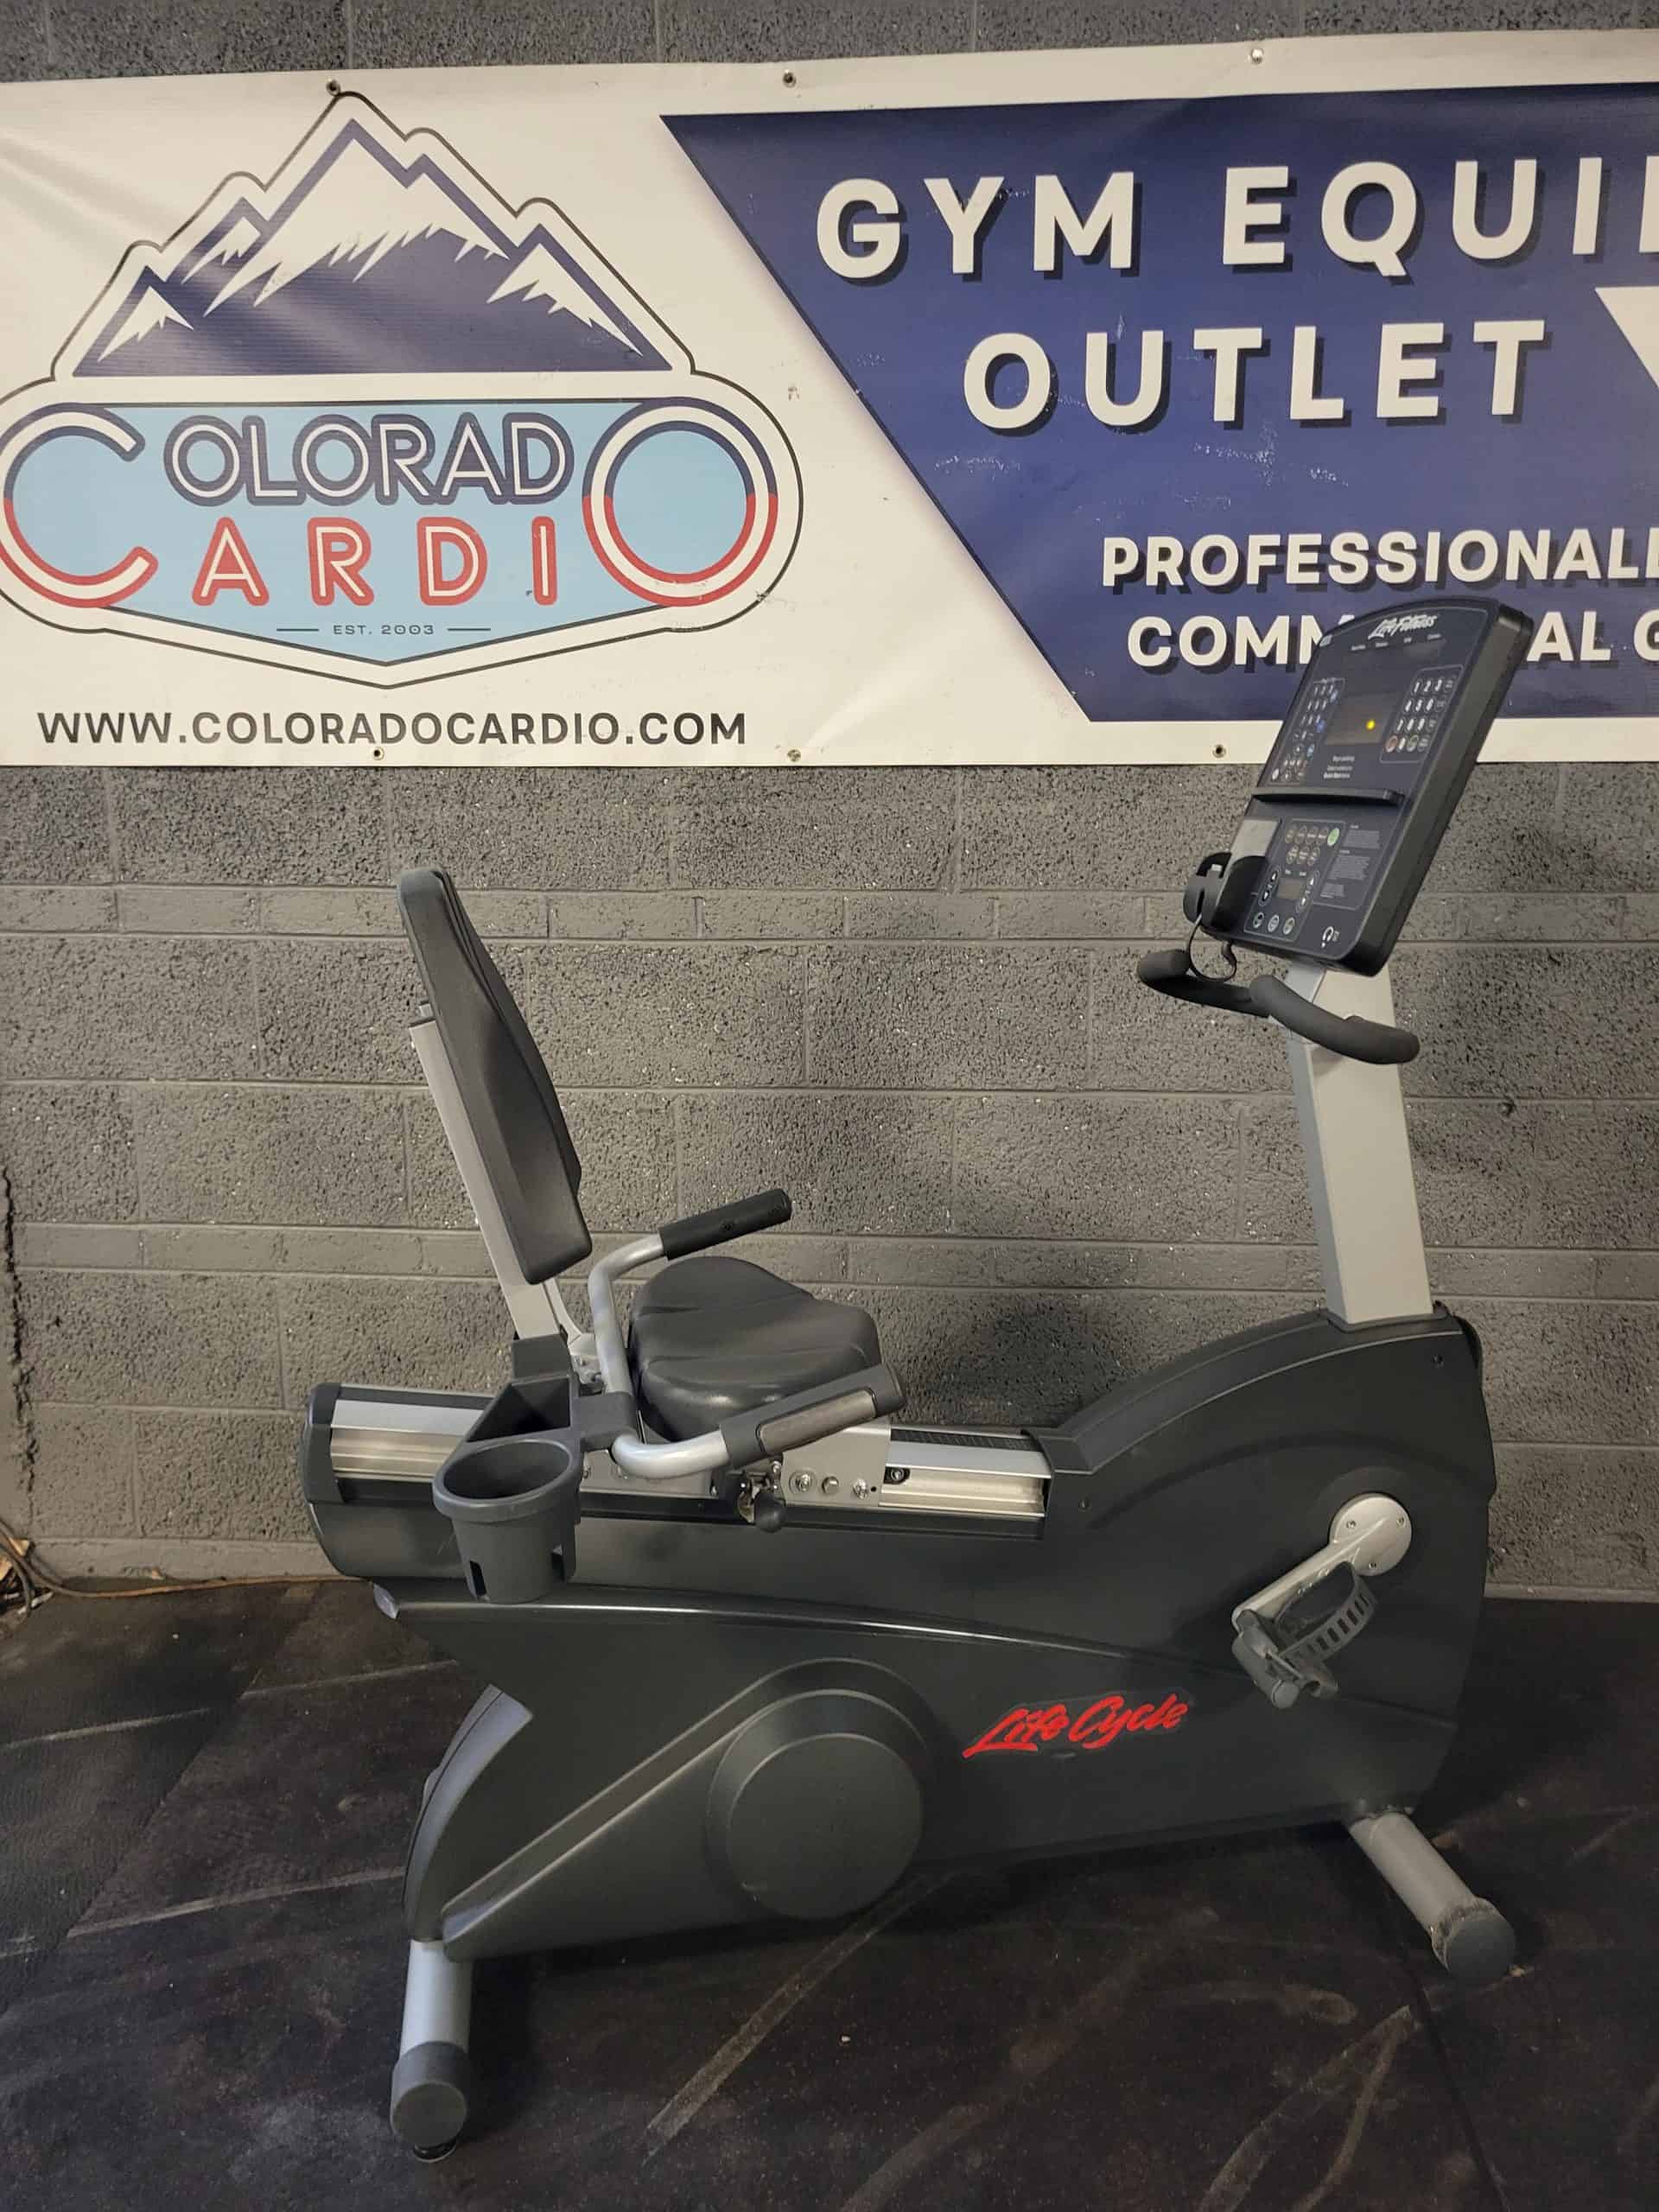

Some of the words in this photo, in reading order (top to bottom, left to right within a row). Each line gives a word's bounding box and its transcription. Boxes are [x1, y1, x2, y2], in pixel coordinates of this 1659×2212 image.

[817, 171, 1135, 279] GYM
[963, 320, 1545, 429] OUTLET
[333, 625, 373, 635] EST.
[381, 625, 434, 635] 2003
[36, 711, 747, 746] WWW.COLORADOCARDIO.COM
[962, 1703, 1070, 1758] Life
[1068, 1695, 1188, 1750] Cycle
